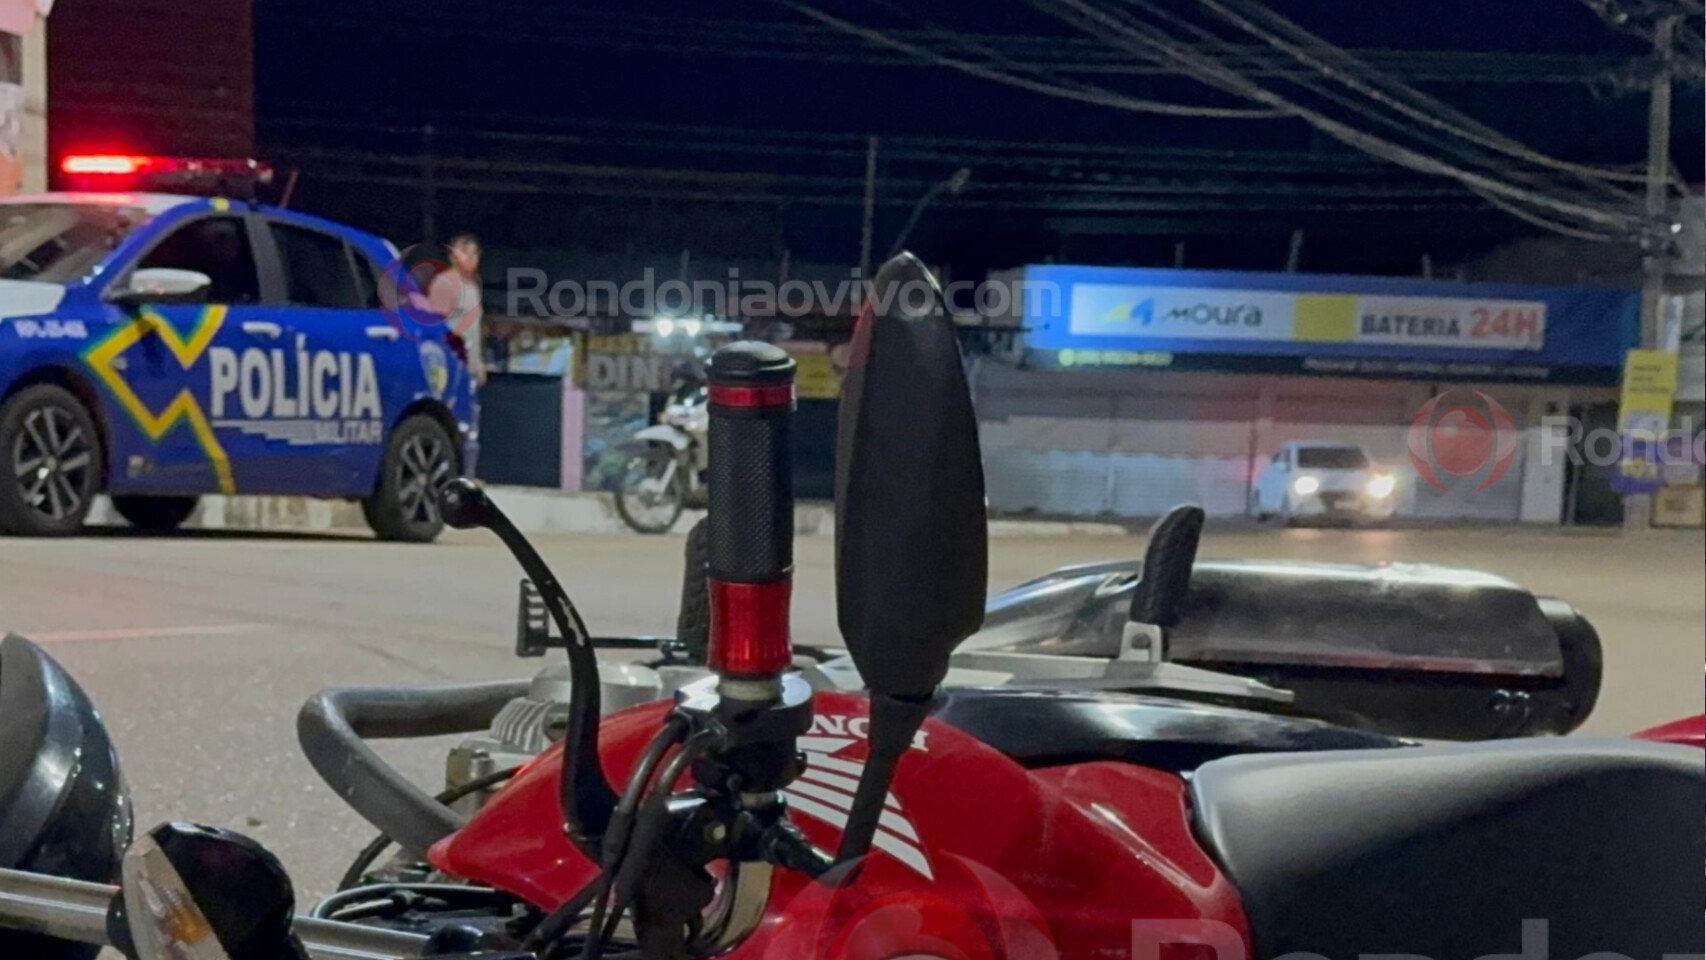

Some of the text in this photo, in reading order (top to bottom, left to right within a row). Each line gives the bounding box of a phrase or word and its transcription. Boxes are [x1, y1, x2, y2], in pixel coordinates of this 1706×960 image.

[1361, 311, 1461, 338] BATERIA
[1469, 306, 1541, 340] 24H
[209, 332, 383, 419] POLÍCIA
